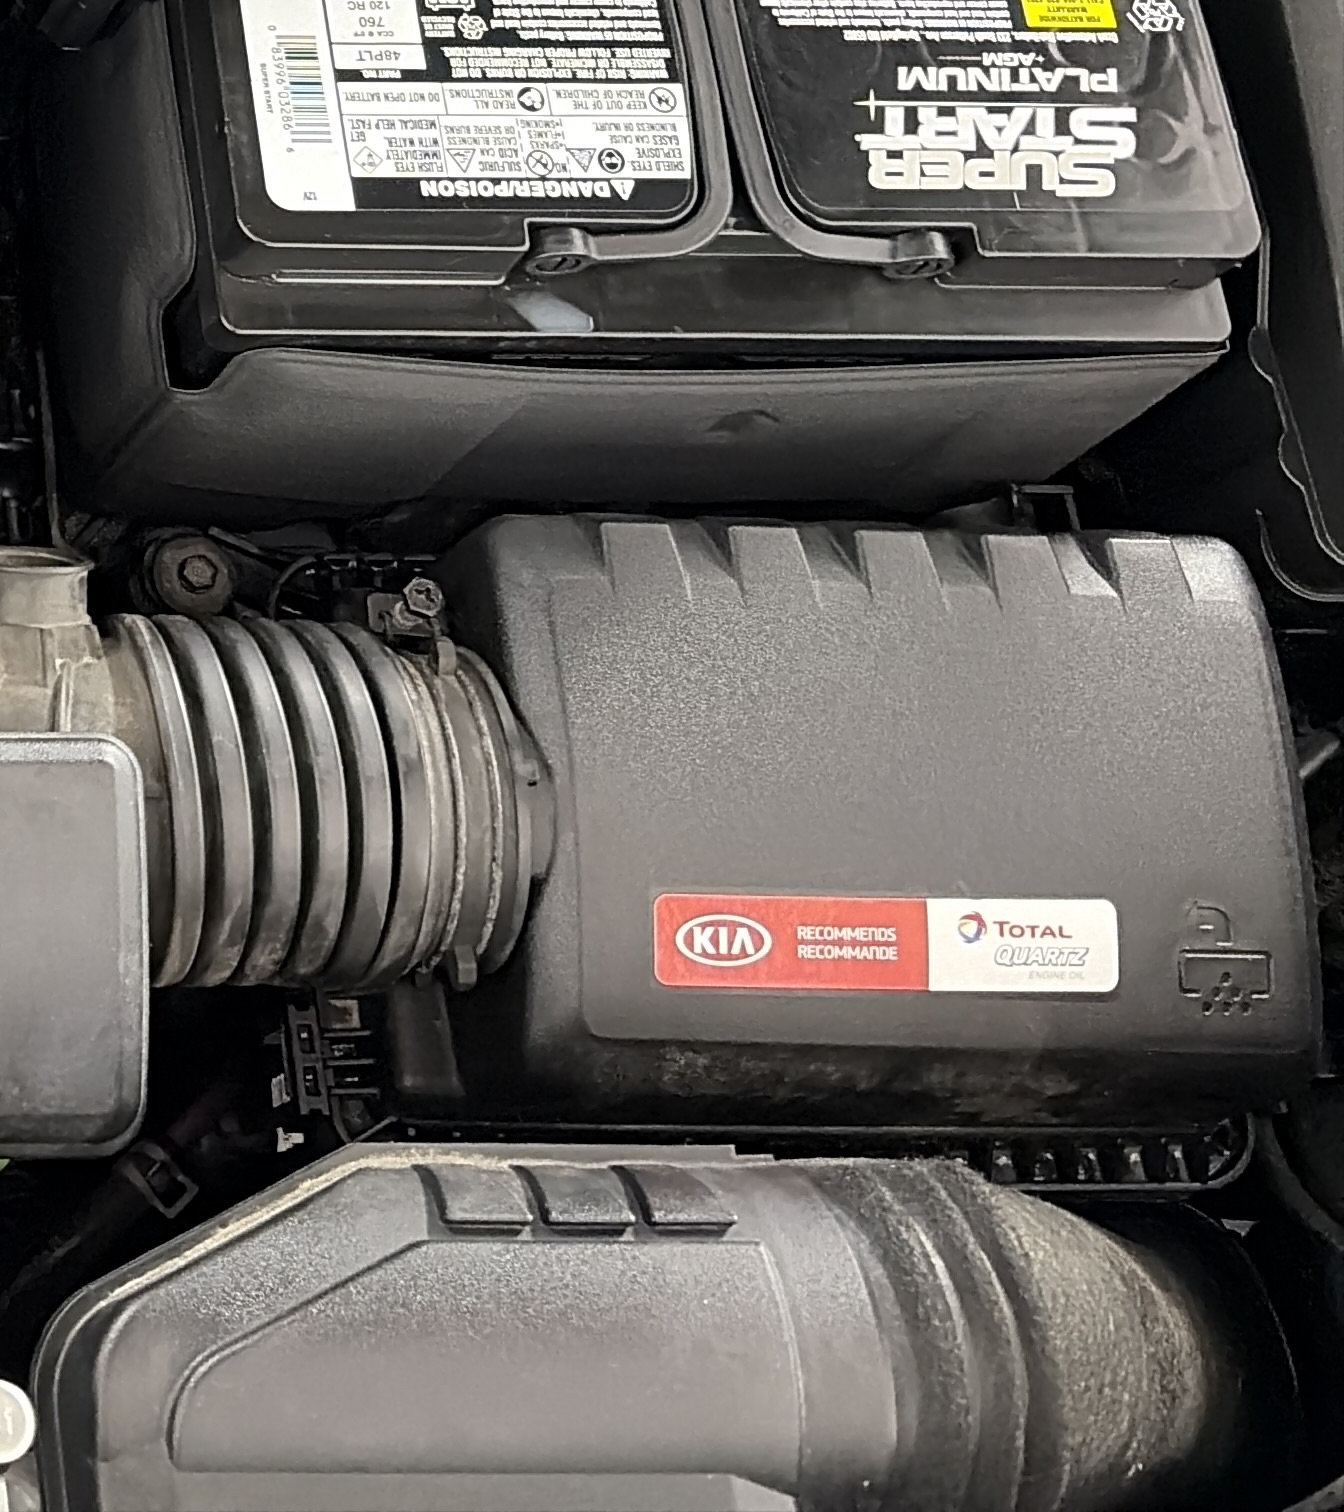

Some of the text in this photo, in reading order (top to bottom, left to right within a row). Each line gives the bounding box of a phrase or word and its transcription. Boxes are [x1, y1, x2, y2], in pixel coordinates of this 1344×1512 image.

[347, 1, 391, 10] 120 RC
[358, 16, 385, 27] 760
[356, 50, 400, 62] 48PLT
[982, 51, 1035, 66] AGM
[897, 66, 1118, 92] PLATINUM
[270, 47, 285, 85] 83996
[278, 91, 293, 130] 03286
[342, 92, 439, 100] DO NOT OPEN BATTERY.
[602, 90, 613, 99] OF
[616, 90, 645, 99] REACH
[264, 90, 275, 114] START
[473, 100, 515, 109] READ ALL
[572, 100, 647, 109] KEEP OUT OF THE
[375, 119, 397, 130] HELP
[399, 119, 437, 130] MEDICAL
[624, 121, 634, 132] OR
[635, 121, 677, 132] BLINDNESS
[350, 131, 366, 141] GET
[473, 125, 502, 136] SEVERE
[504, 125, 515, 136] OR
[855, 106, 1136, 158] START
[417, 137, 439, 147] WITH
[446, 136, 491, 146] BLINDNESS
[493, 136, 517, 147] CAUSE
[608, 134, 679, 145] GASES CAN CAUSE
[385, 150, 441, 159] IMMEDIATELY
[479, 148, 518, 157] ACID CAN
[635, 148, 682, 158] EXPLOSIVE
[394, 162, 443, 172] FLUSH EYES
[478, 161, 521, 171] SULFURIC
[655, 161, 684, 171] SHIELD
[868, 147, 1117, 196] SUPER
[419, 179, 610, 197] DANGER/POISON
[796, 925, 897, 943] RECOMMENDS
[993, 919, 1074, 940] TOTAL
[691, 924, 756, 958] KIA
[796, 944, 899, 962] RECOMMANDE
[993, 943, 1090, 967] QUARTZ
[1027, 970, 1086, 980] ENGINE OIL
